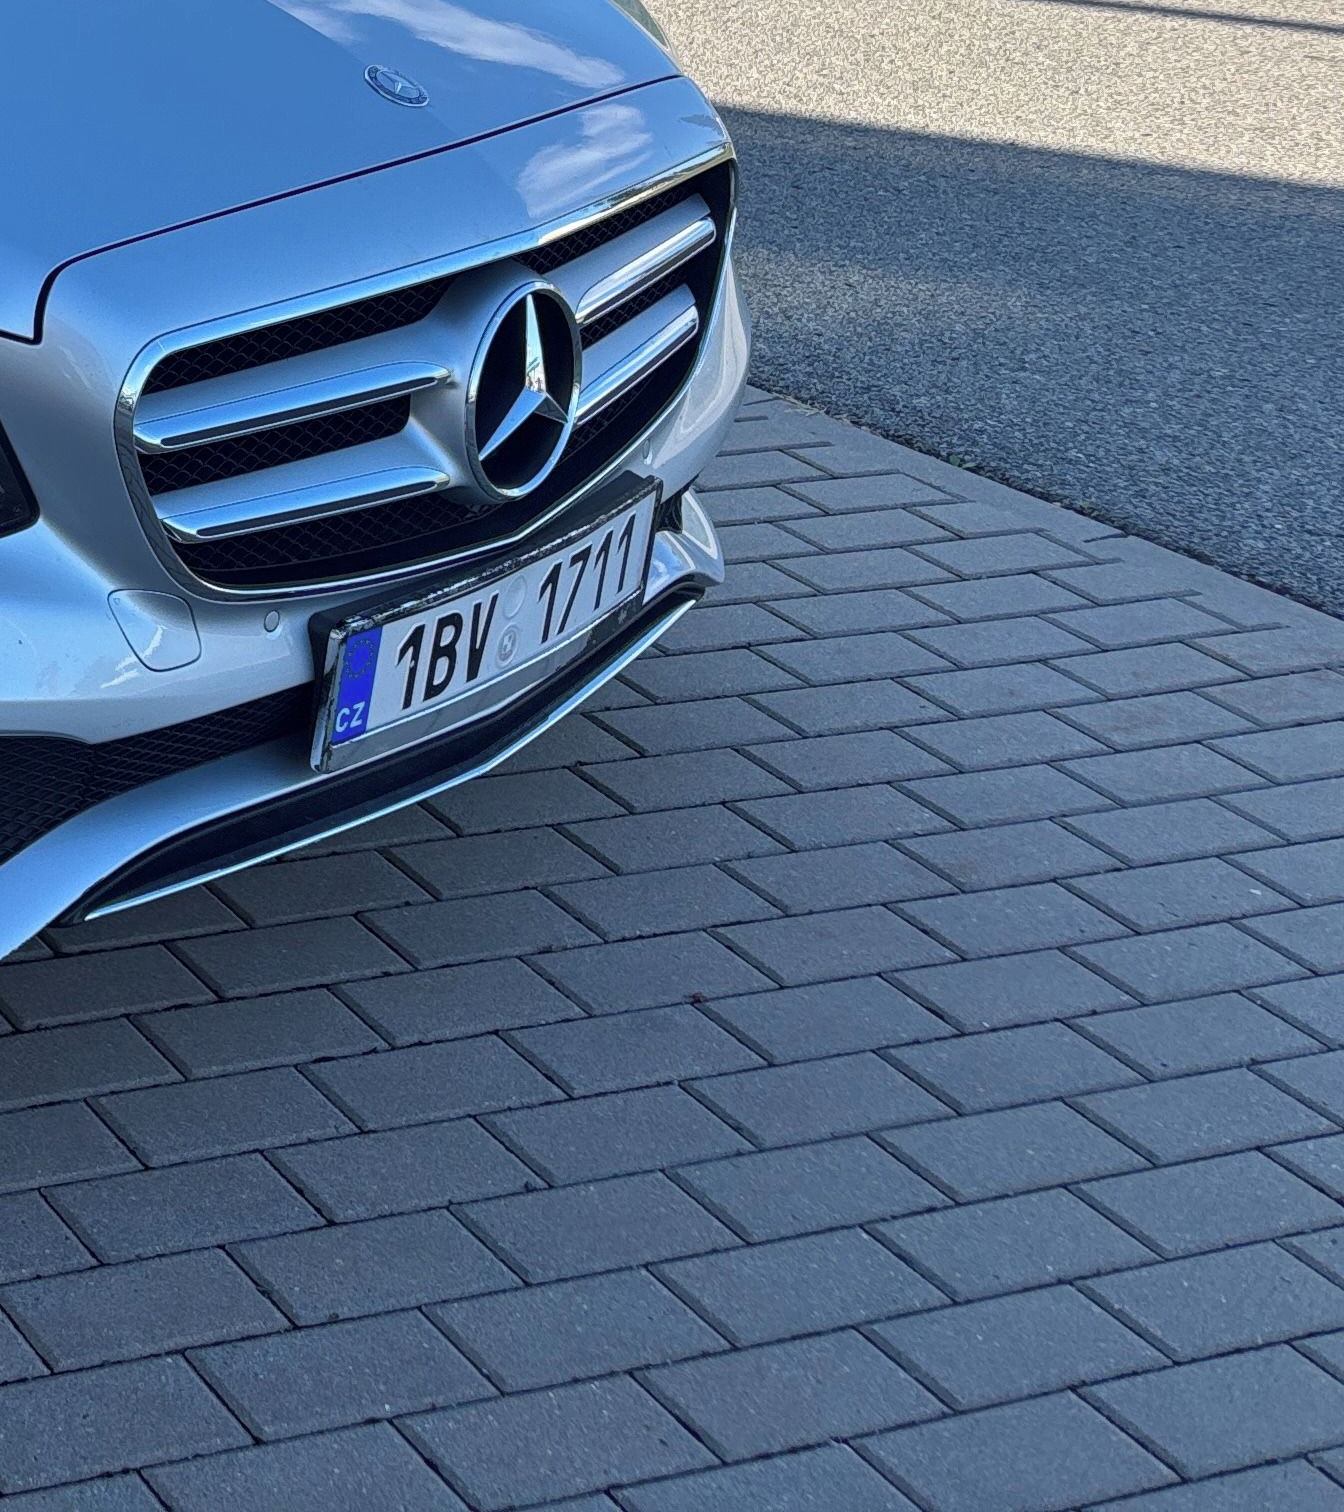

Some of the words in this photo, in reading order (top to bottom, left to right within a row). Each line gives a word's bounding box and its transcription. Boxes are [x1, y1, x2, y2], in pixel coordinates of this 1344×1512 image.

[395, 591, 500, 711] 1BV
[538, 512, 636, 644] 1711
[335, 701, 366, 733] CZ
